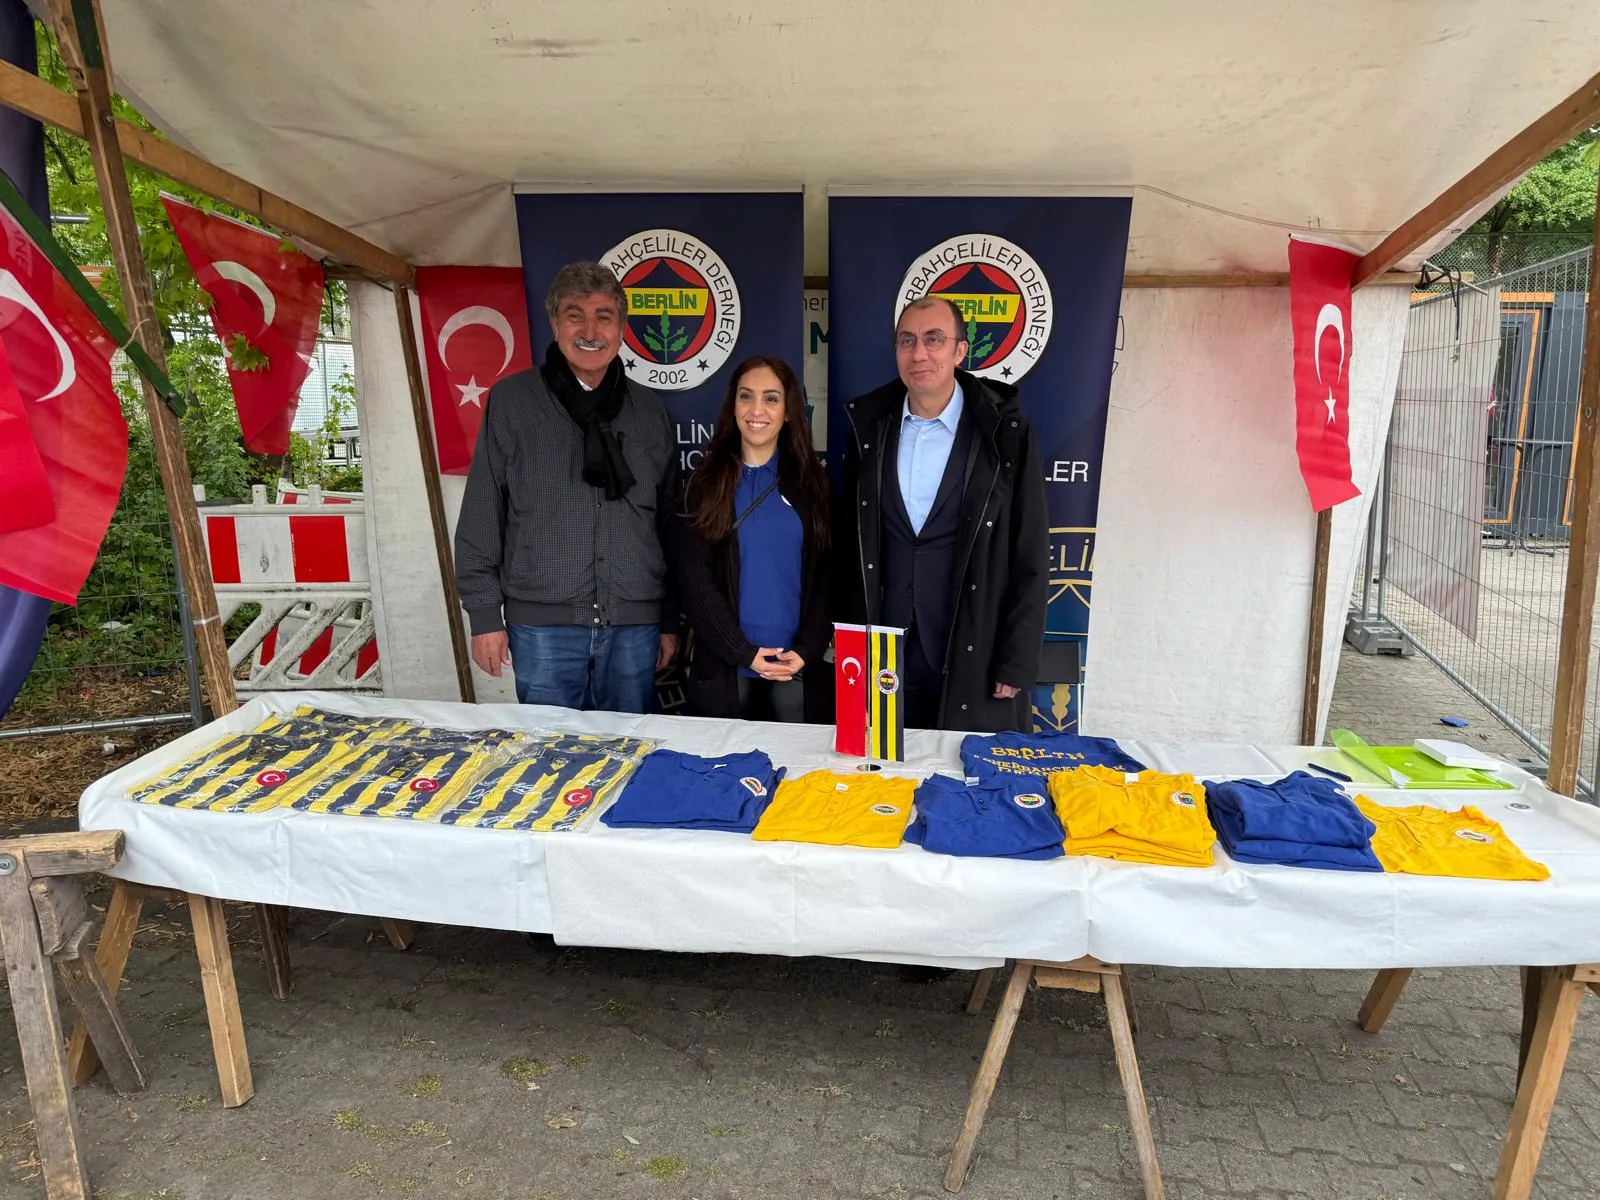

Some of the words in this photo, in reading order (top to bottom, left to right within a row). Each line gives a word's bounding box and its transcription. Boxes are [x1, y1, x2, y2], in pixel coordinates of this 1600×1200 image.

[631, 290, 697, 310] BERLİN
[705, 262, 735, 353] DERNEĞİ
[1010, 267, 1046, 361] DERNEĞİ
[648, 369, 689, 385] 2002
